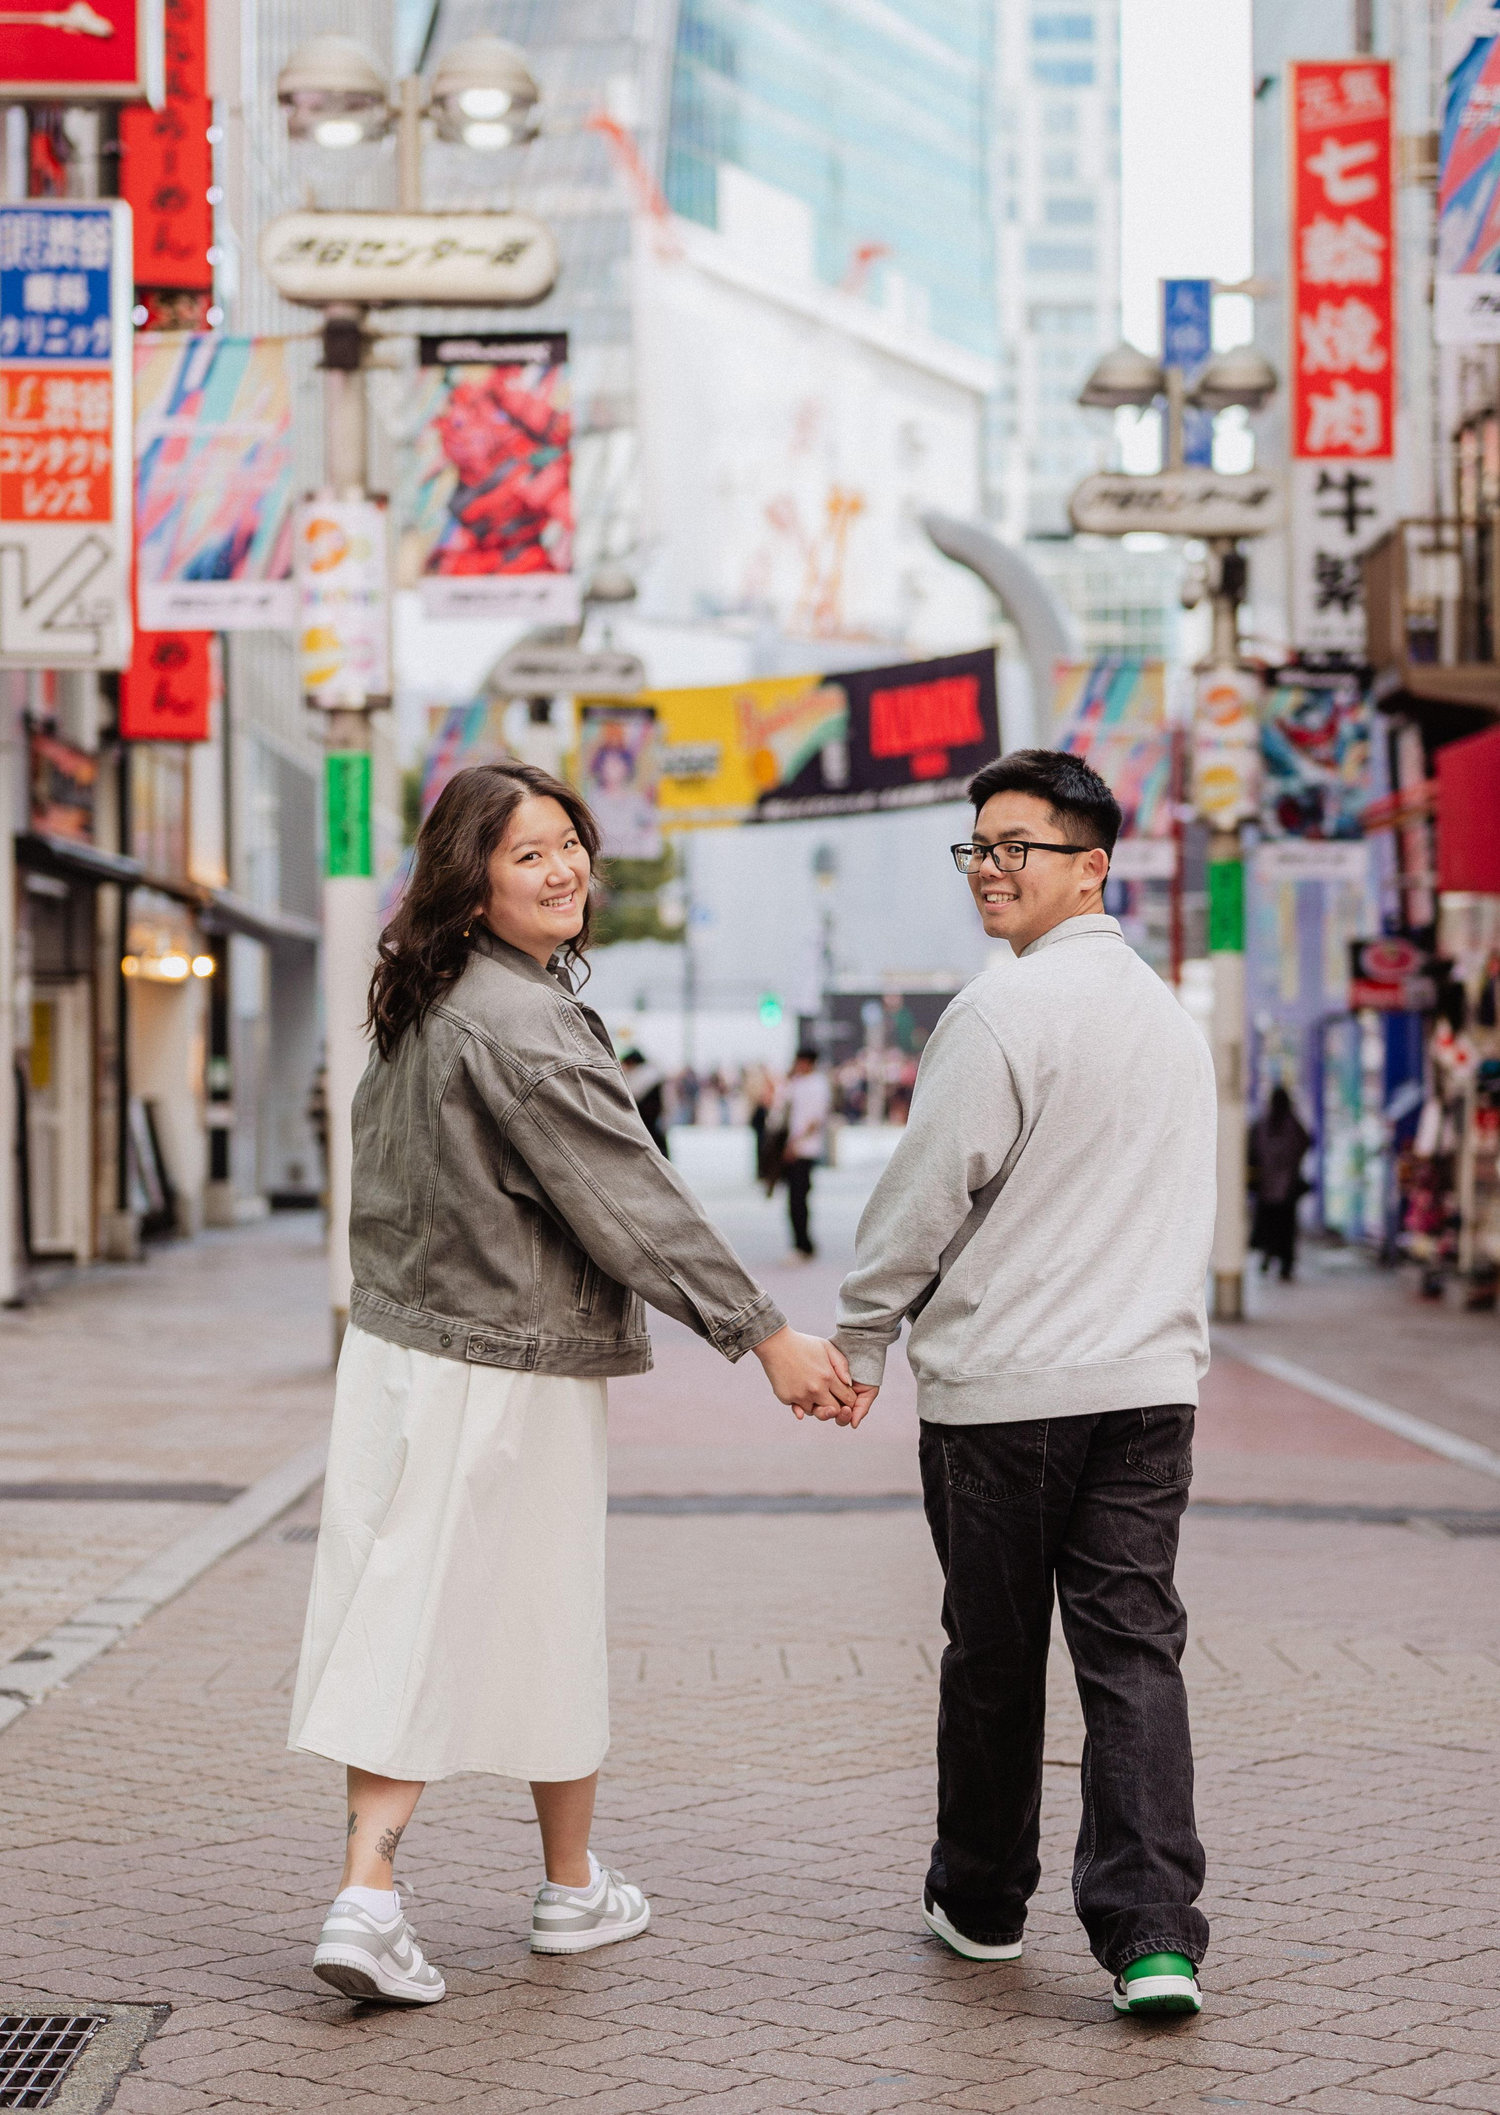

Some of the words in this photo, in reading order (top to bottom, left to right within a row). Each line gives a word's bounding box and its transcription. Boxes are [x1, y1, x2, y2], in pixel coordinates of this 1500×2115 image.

[0, 314, 109, 356] クリニック
[0, 436, 109, 475] コンタクト
[23, 477, 93, 516] レンズ
